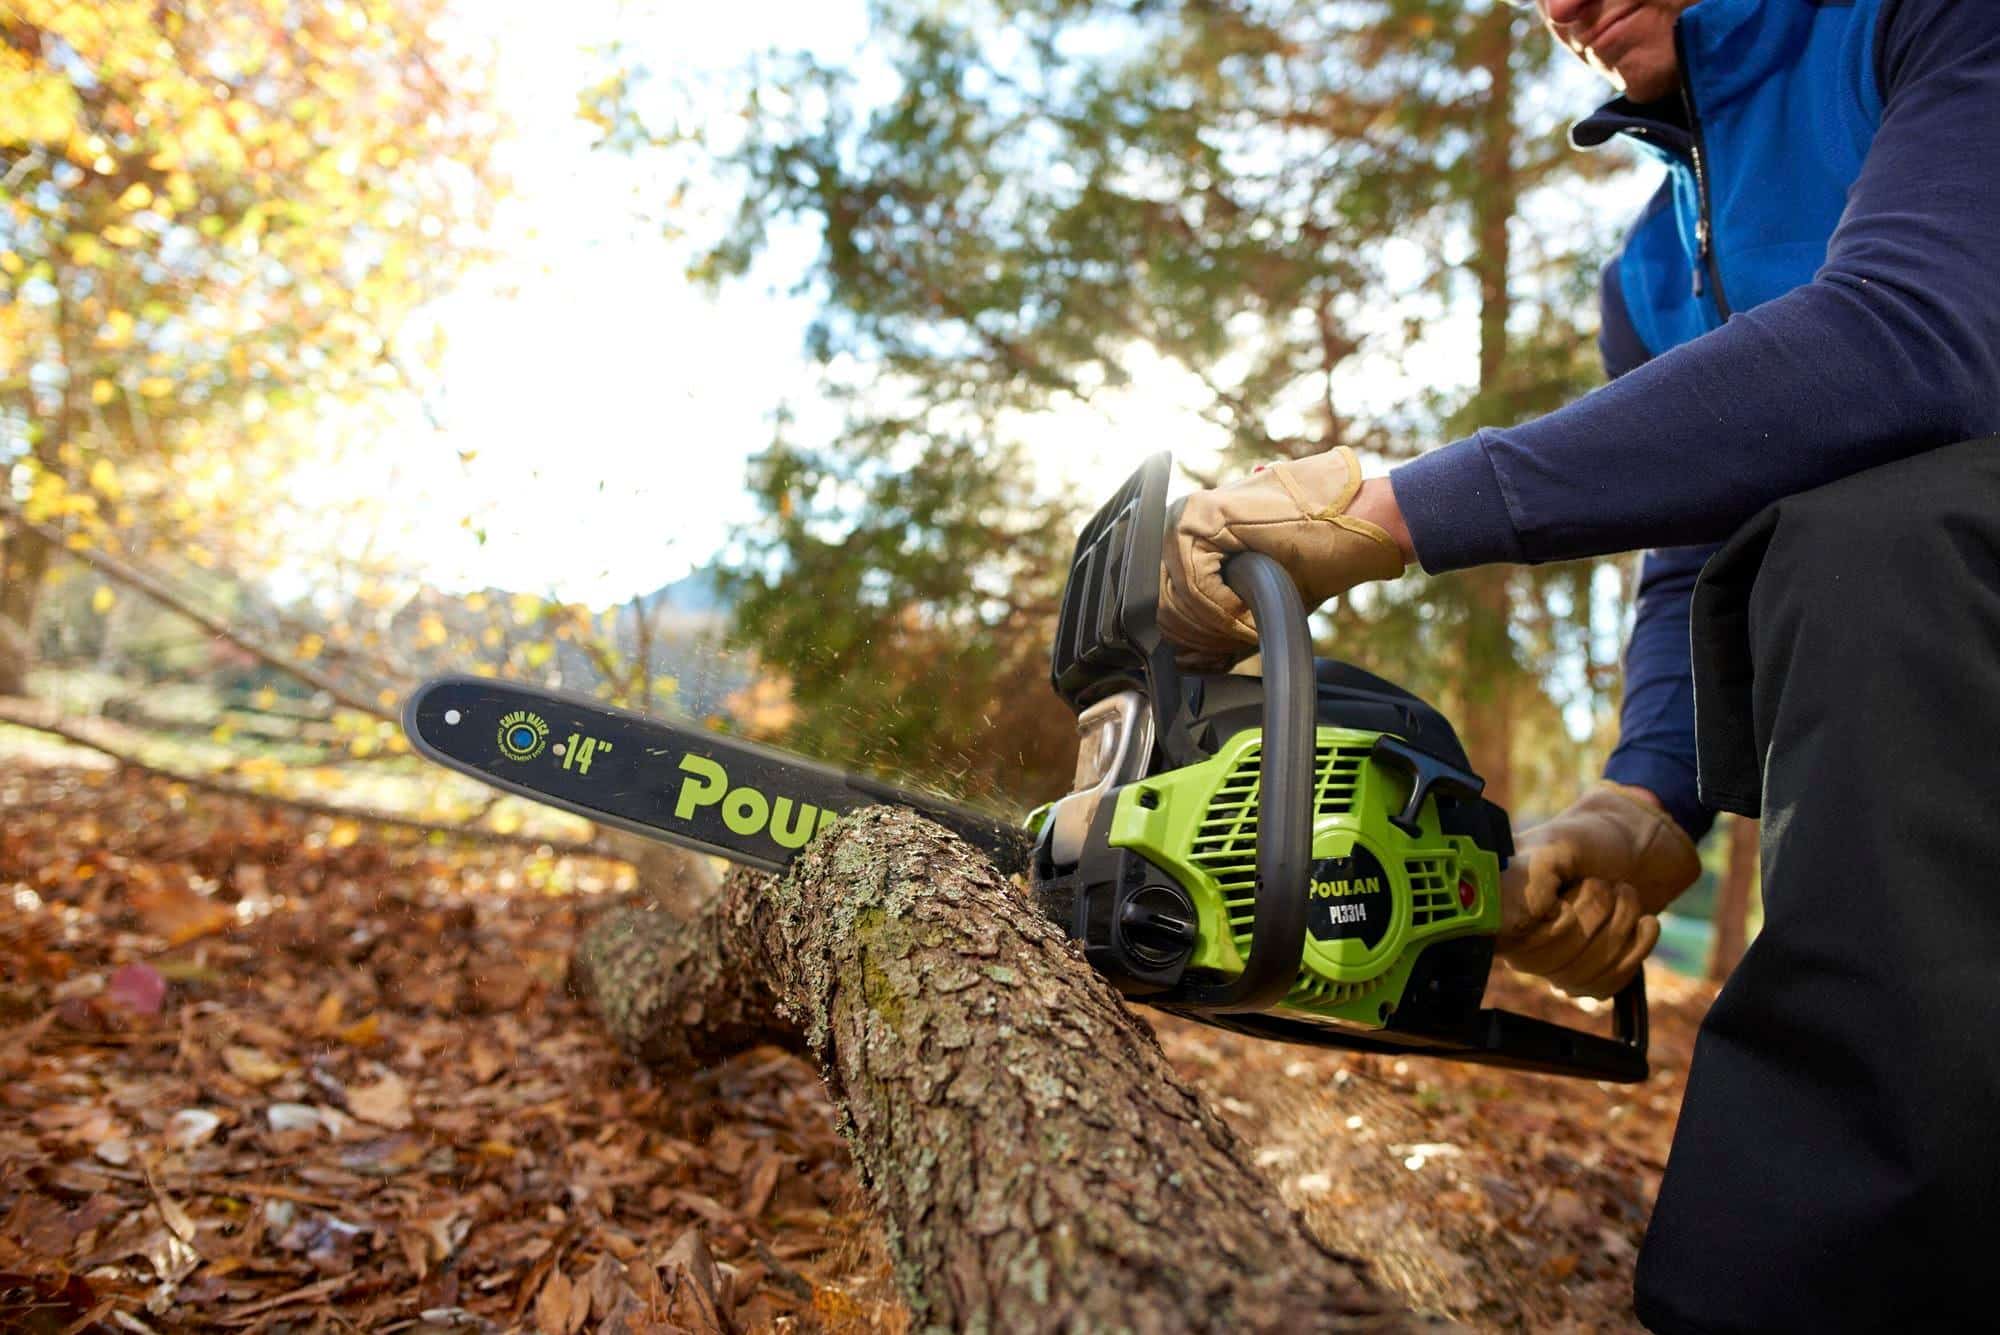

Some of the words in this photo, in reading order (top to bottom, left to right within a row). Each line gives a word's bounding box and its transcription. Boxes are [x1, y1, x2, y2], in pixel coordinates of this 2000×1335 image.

[526, 711, 549, 736] MATCH
[563, 733, 613, 775] 14"
[1309, 877, 1380, 899] POULAN
[1329, 903, 1367, 924] PL3314
